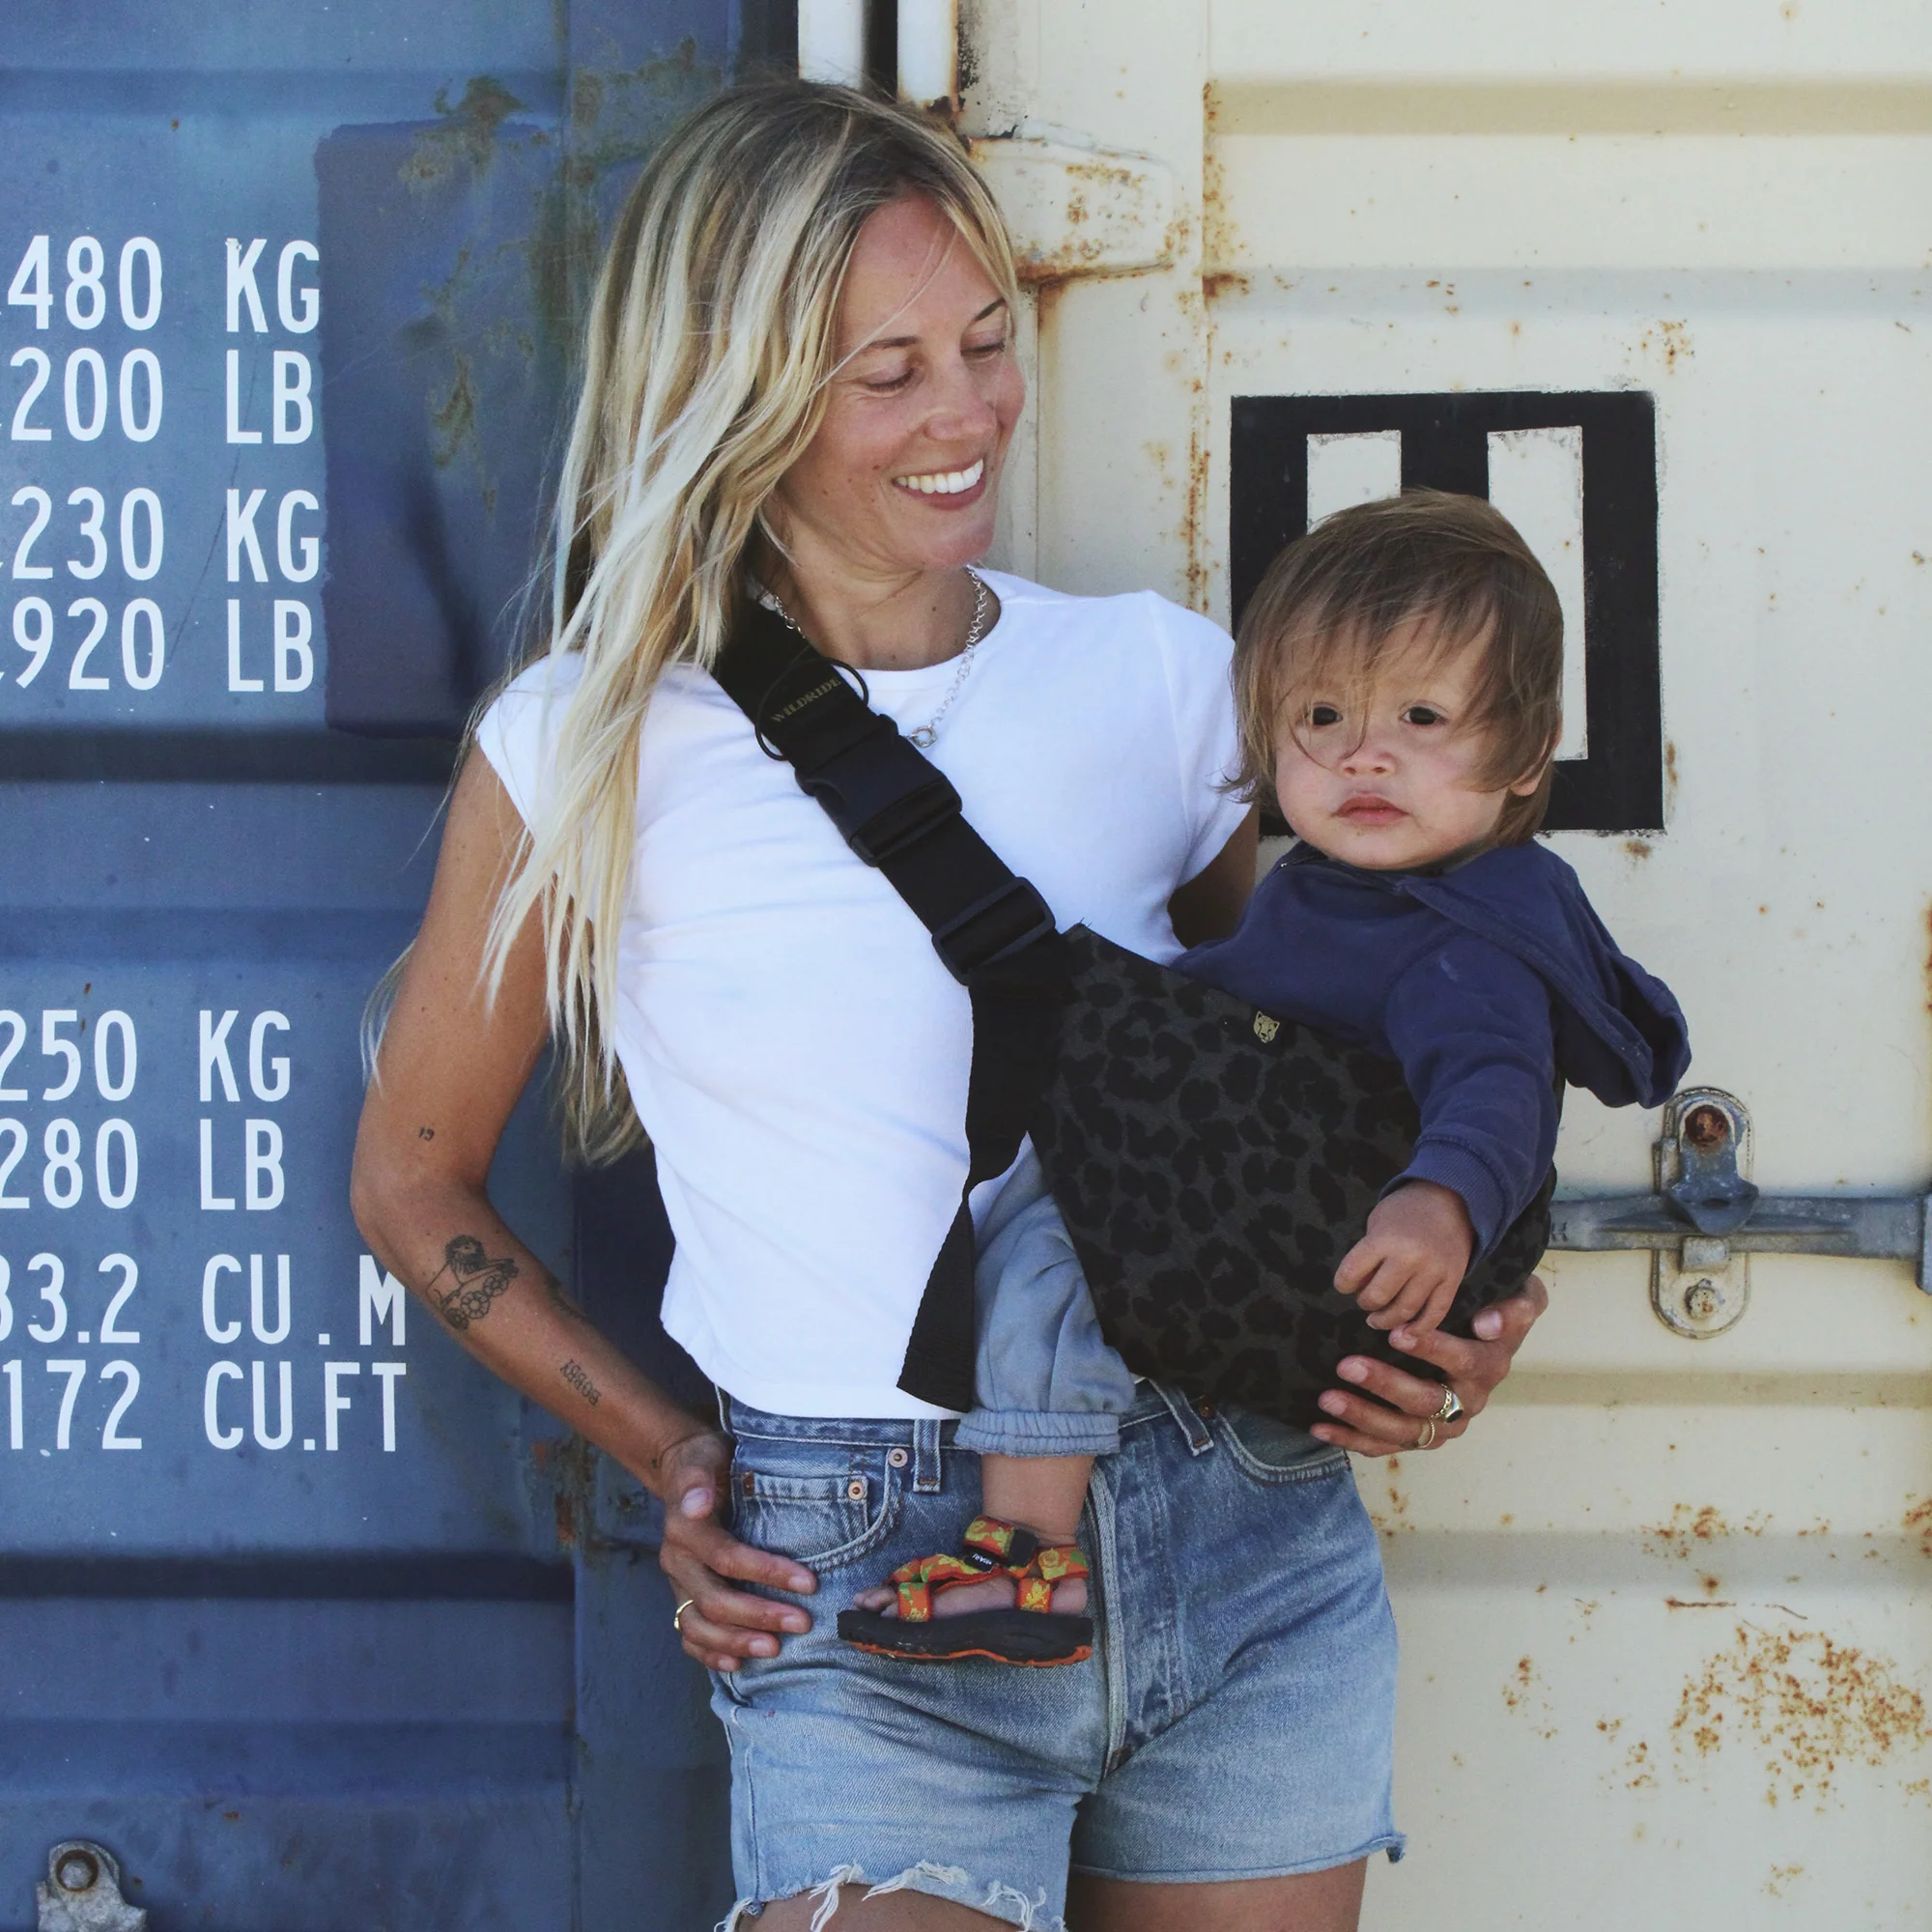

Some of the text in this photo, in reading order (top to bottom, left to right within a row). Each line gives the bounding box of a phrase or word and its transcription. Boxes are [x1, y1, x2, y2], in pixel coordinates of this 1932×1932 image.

[0, 233, 321, 333] 480 KG
[0, 345, 314, 444] 200 LB
[0, 484, 320, 583] 230 KG
[0, 595, 314, 693] 920 LB
[0, 1008, 291, 1102] 250 KG
[0, 1117, 285, 1210] 280 LB
[2, 1359, 407, 1452] 172 CU.FT
